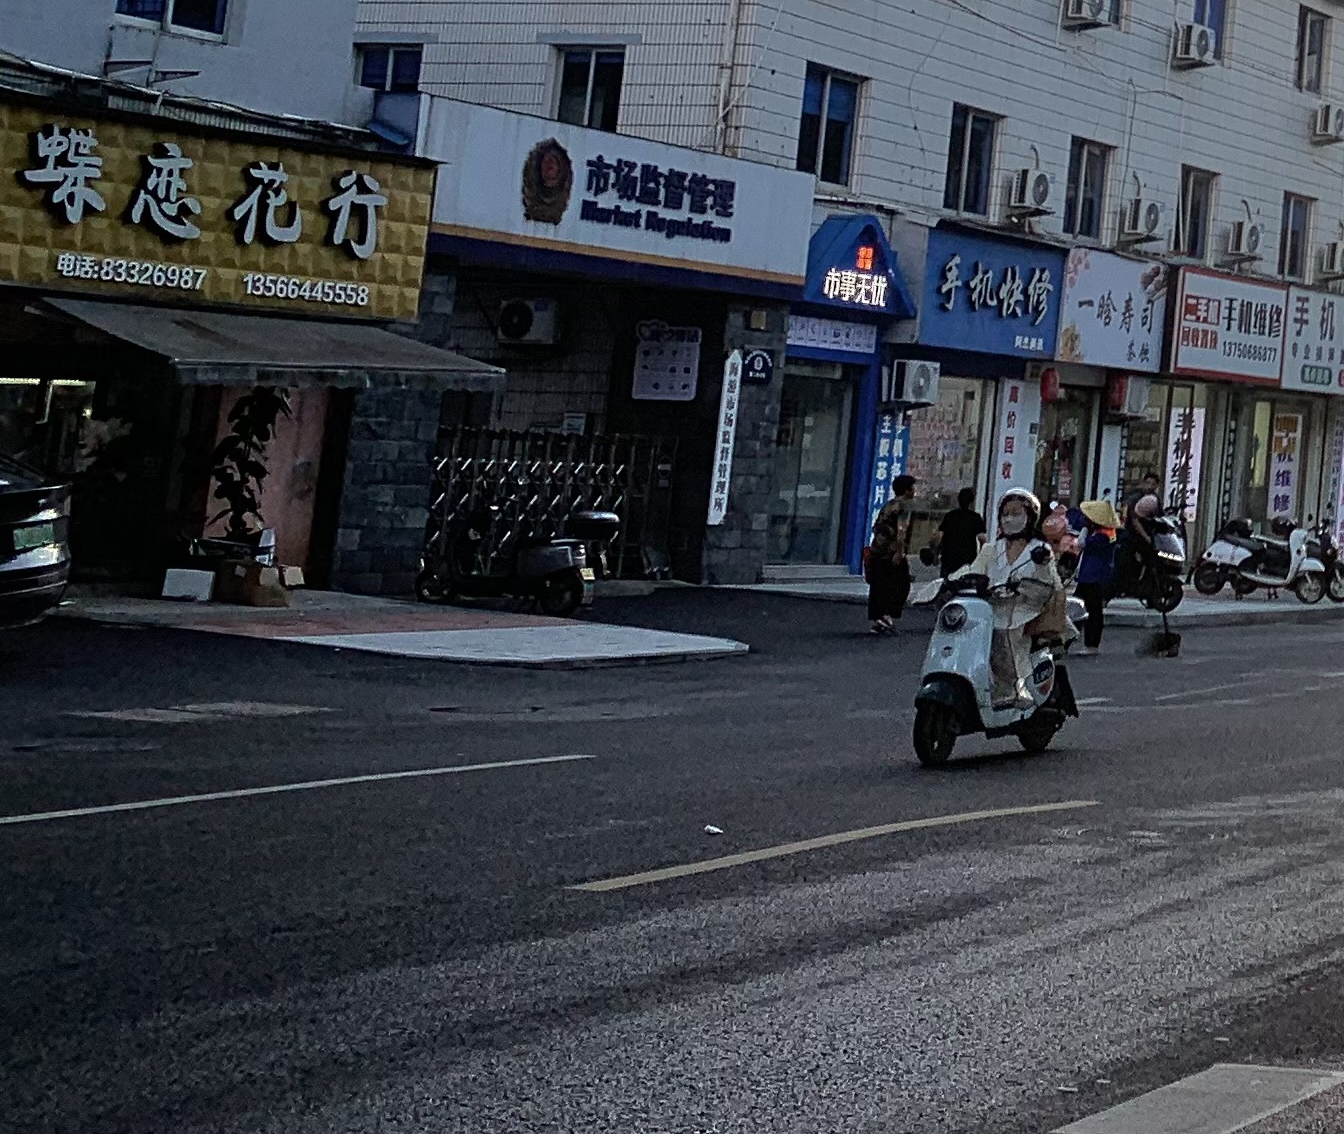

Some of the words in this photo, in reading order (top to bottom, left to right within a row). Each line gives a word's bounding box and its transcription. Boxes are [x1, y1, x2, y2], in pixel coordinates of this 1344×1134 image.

[24, 126, 390, 260] 蝶恋花行
[585, 154, 737, 219] 市场监督管理
[580, 198, 642, 229] Market
[57, 252, 208, 291] 电话:83326987
[243, 271, 370, 307] 13566445558
[940, 253, 1054, 327] 手机快修
[1221, 295, 1283, 340] 手机维修
